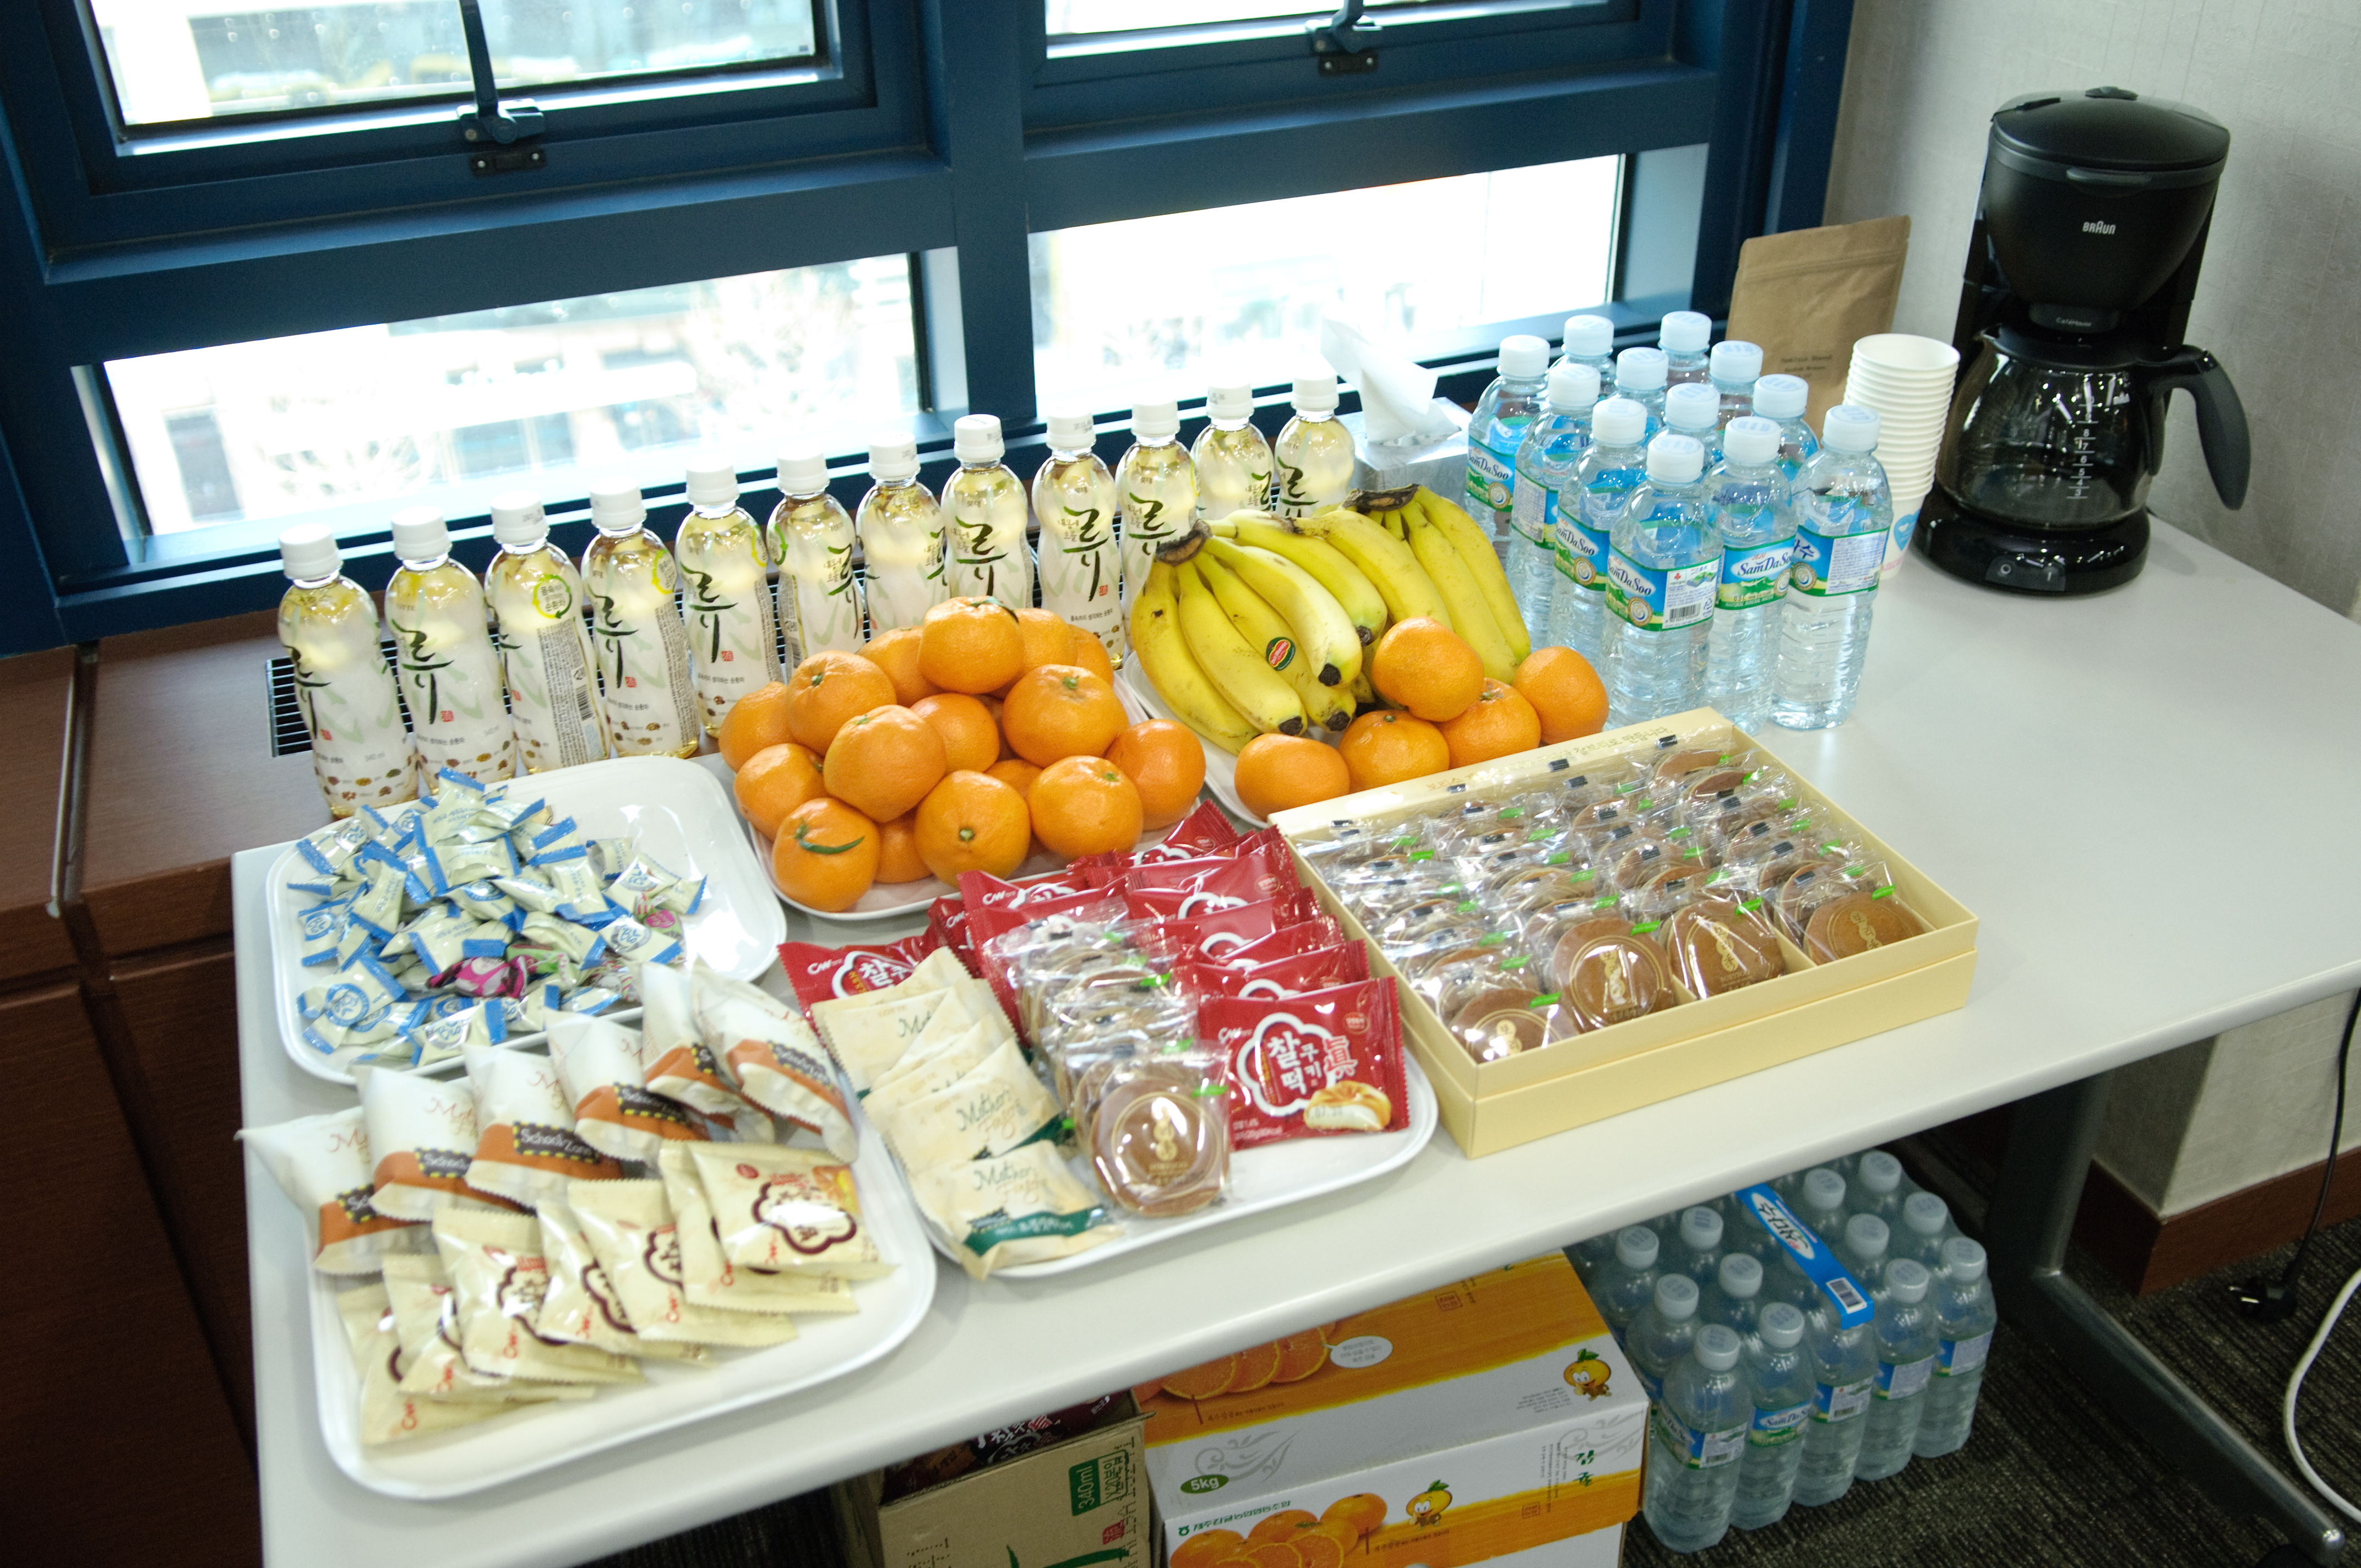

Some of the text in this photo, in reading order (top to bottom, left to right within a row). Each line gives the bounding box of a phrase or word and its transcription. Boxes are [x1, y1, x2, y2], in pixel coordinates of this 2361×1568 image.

[2082, 221, 2117, 235] BRAUN
[1063, 505, 1110, 602] 류
[1737, 552, 1792, 576] SamDaSo
[679, 561, 739, 663] 류
[390, 618, 455, 725] 류
[857, 956, 895, 988] 찰
[519, 1127, 564, 1148] School
[1078, 1464, 1094, 1510] 340ml
[1189, 1476, 1221, 1493] 5kg
